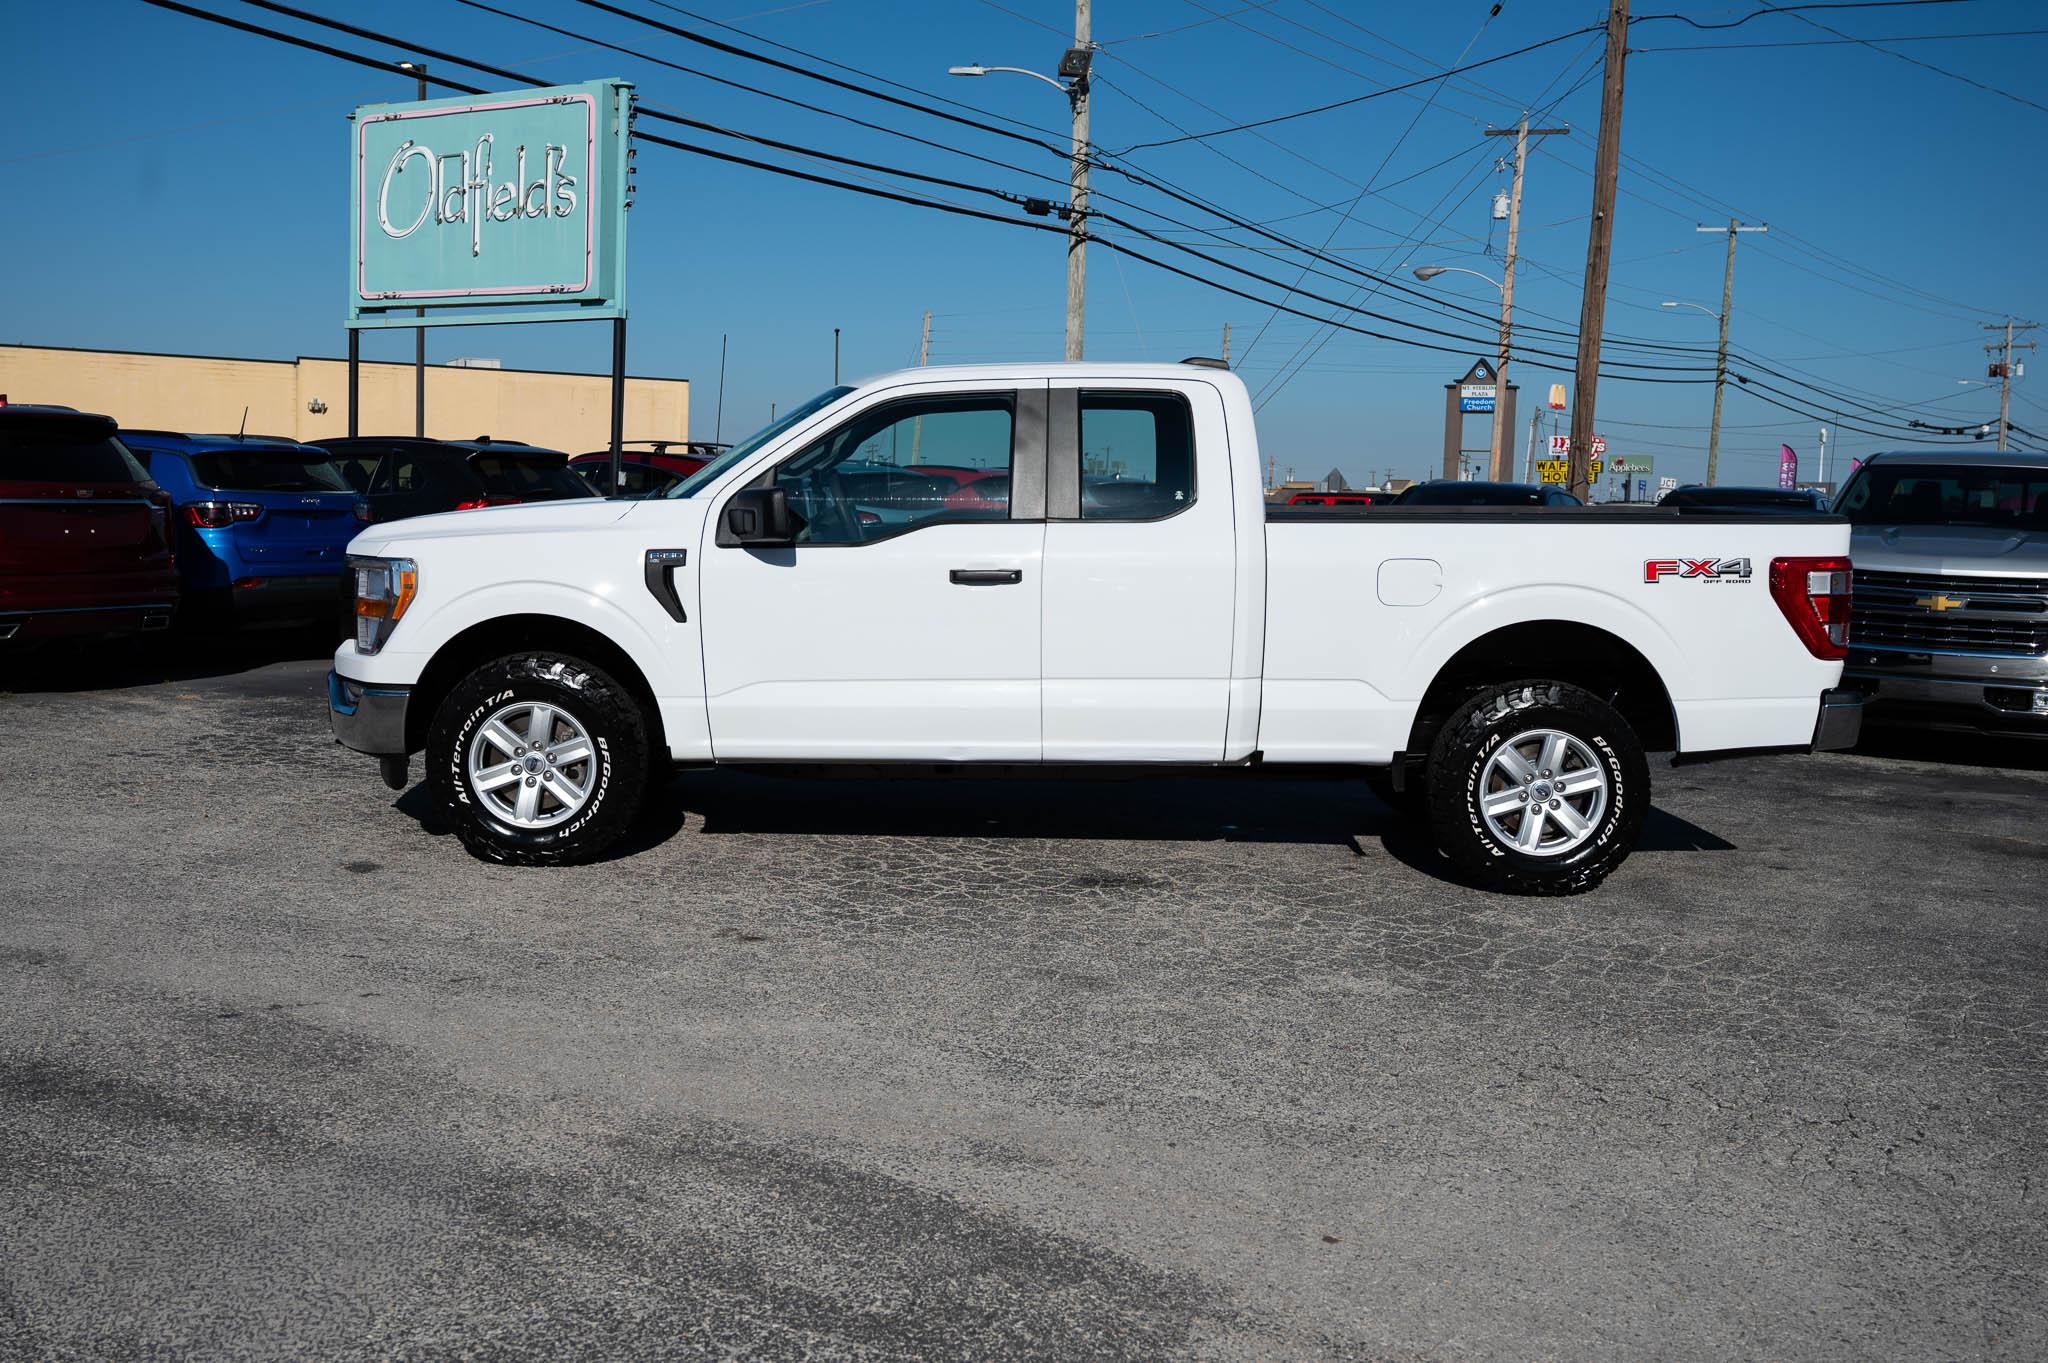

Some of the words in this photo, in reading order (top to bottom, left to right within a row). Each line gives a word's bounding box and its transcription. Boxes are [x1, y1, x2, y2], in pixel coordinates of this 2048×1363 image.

[377, 133, 578, 258] Oldfield's
[1536, 461, 1600, 471] WAFE
[1662, 479, 1675, 488] JCT
[1644, 558, 1752, 584] FX4
[451, 706, 485, 805] All-Terrain
[485, 689, 515, 707] T/A
[559, 736, 611, 838] BFGoodrich
[1478, 733, 1501, 759] T/A
[1592, 735, 1624, 846] BFGoodrich
[1466, 762, 1505, 857] All-Terrain
